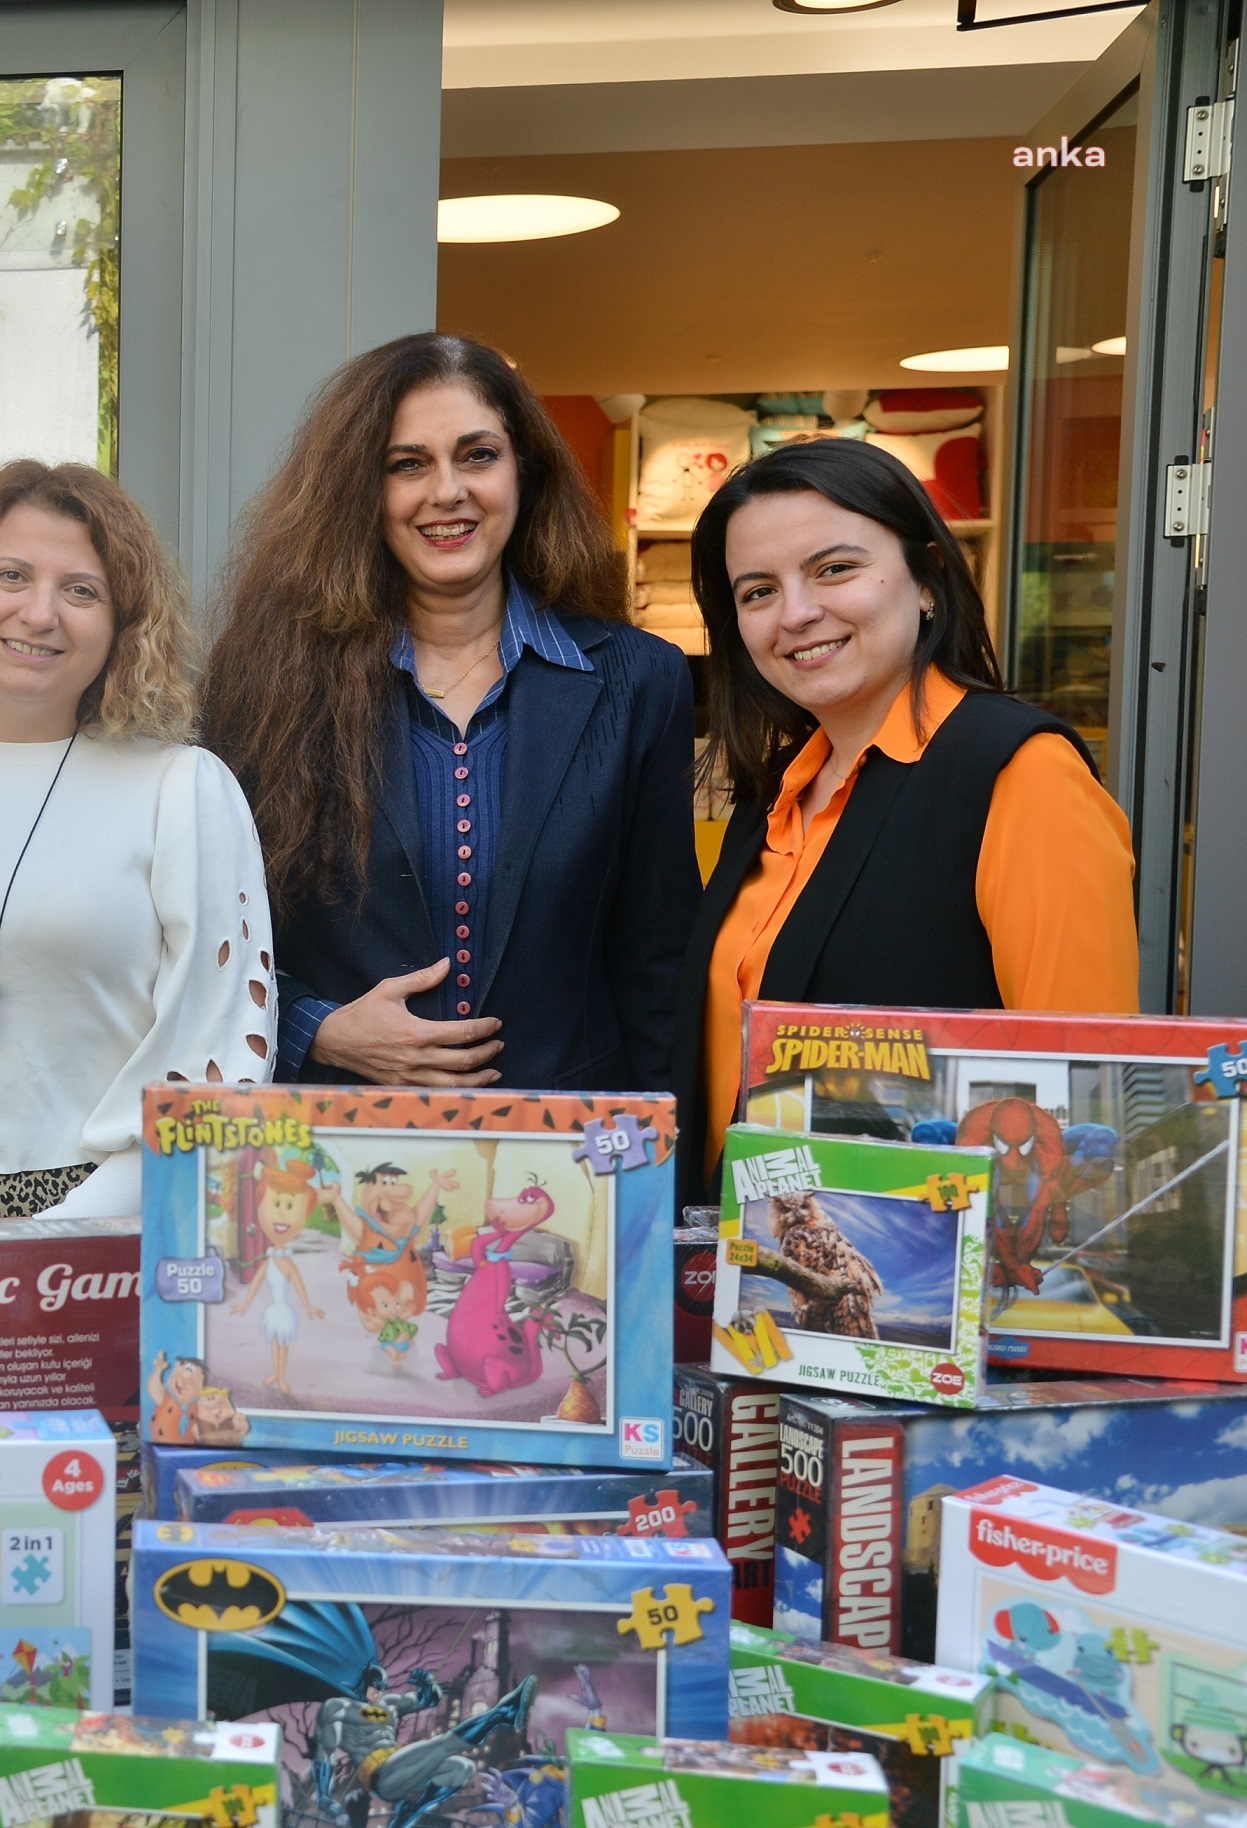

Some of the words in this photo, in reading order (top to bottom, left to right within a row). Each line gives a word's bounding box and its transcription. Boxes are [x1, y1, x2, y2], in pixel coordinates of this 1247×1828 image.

[776, 1024, 846, 1037] SPIDER
[865, 1027, 923, 1040] SENSE
[765, 1038, 931, 1080] SPIDER-MAN
[191, 1099, 220, 1114] THE
[594, 1131, 630, 1156] 50
[754, 1170, 821, 1201] PLANET
[167, 1263, 215, 1280] Puzzle
[177, 1277, 203, 1295] 50
[798, 1364, 836, 1380] JIGSAW
[840, 1369, 880, 1387] PUZZLE
[931, 1372, 963, 1384] ZOE
[333, 1430, 398, 1447] JIGSAW
[402, 1433, 469, 1450] PUZZLE
[623, 1422, 659, 1443] KS
[779, 1422, 825, 1459] LANDSCAPE
[624, 1444, 660, 1458] Puzzle
[64, 1459, 81, 1477] 4
[780, 1444, 824, 1487] 500
[52, 1478, 94, 1496] Ages
[727, 1394, 780, 1560] GALLERY
[634, 1505, 676, 1530] 200
[9, 1536, 21, 1551] 2
[24, 1536, 41, 1551] in
[45, 1536, 53, 1550] 1
[839, 1436, 895, 1656] LANDSCAP
[976, 1518, 1109, 1576] fisher-price
[647, 1604, 679, 1626] 50
